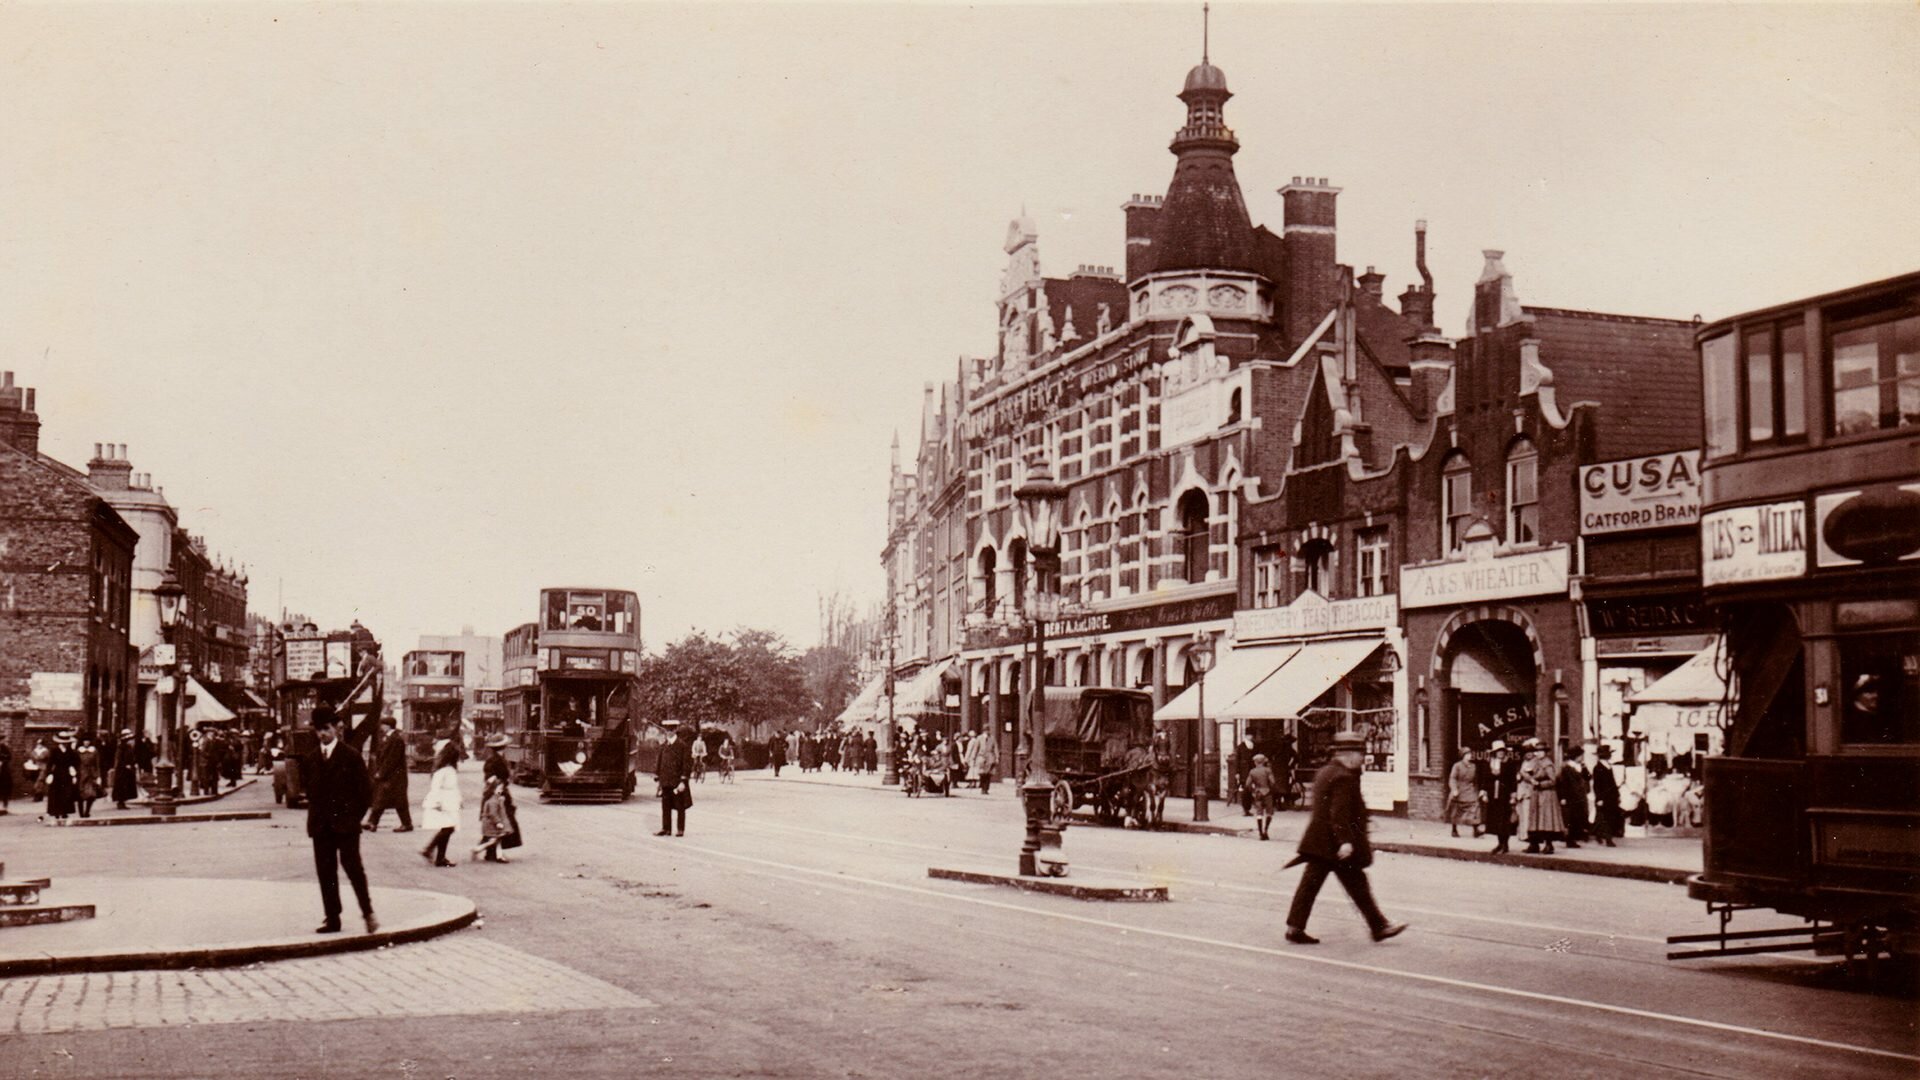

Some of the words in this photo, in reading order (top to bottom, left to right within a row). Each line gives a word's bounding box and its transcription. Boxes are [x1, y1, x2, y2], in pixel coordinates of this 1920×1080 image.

[1584, 455, 1695, 498] CUSA
[1584, 508, 1651, 529] CATFORD
[1655, 504, 1697, 522] BRAN
[1710, 517, 1735, 561] LES
[1757, 506, 1805, 555] MILK
[577, 606, 596, 617] 50
[1302, 606, 1327, 628] TEAS
[1332, 601, 1382, 625] TOBACCO
[1478, 723, 1491, 737] A
[1493, 714, 1504, 727] &
